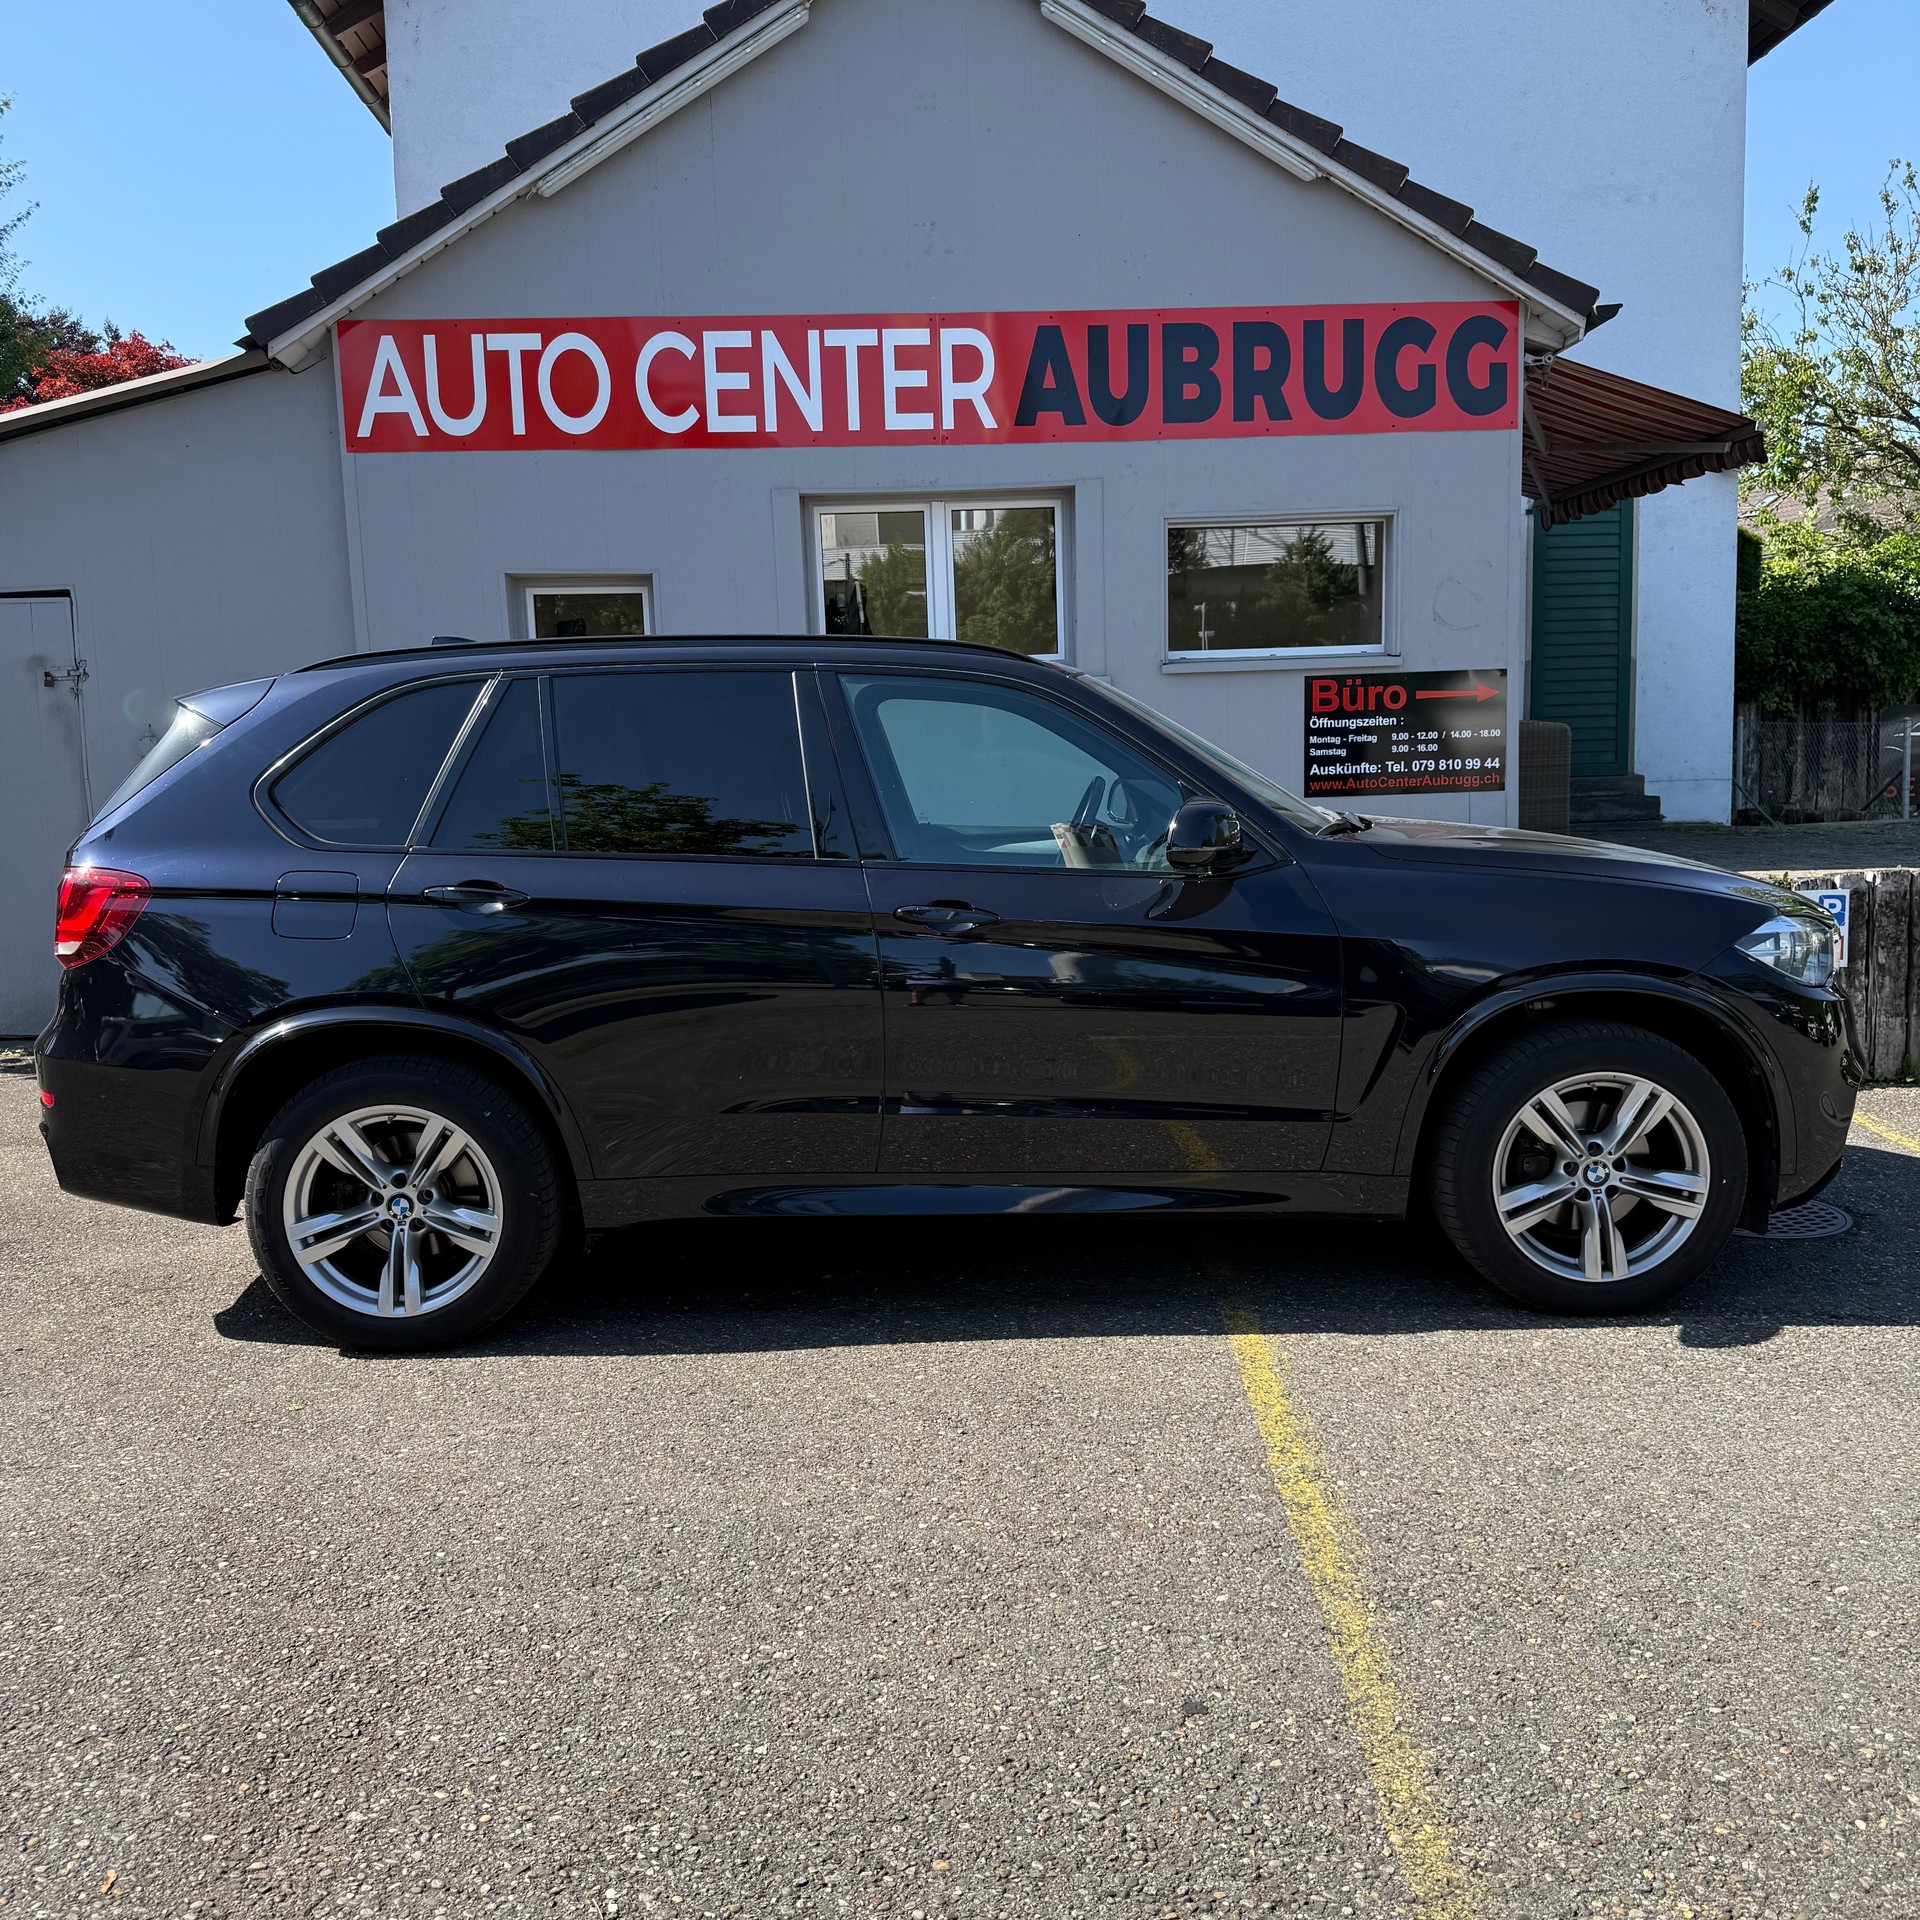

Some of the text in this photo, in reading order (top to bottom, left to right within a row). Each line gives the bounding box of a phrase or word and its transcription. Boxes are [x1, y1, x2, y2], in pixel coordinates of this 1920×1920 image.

[355, 315, 1510, 439] AUTO CENTER AUBRUGG
[1312, 679, 1407, 712] Büro
[1310, 716, 1396, 729] Öffnungszeiten
[1310, 735, 1340, 744] Montag
[1349, 734, 1377, 743] Freitag
[1450, 730, 1471, 738] 14.00
[1480, 729, 1500, 737] 18.00
[1310, 748, 1346, 756] Samstag
[1392, 745, 1409, 753] 9.00
[1417, 744, 1438, 752] 16.00
[1310, 757, 1500, 775] Auskünfte: Tel. 079 810 99 44
[1310, 772, 1500, 790] www.AutoCenterAubrugg.ch
